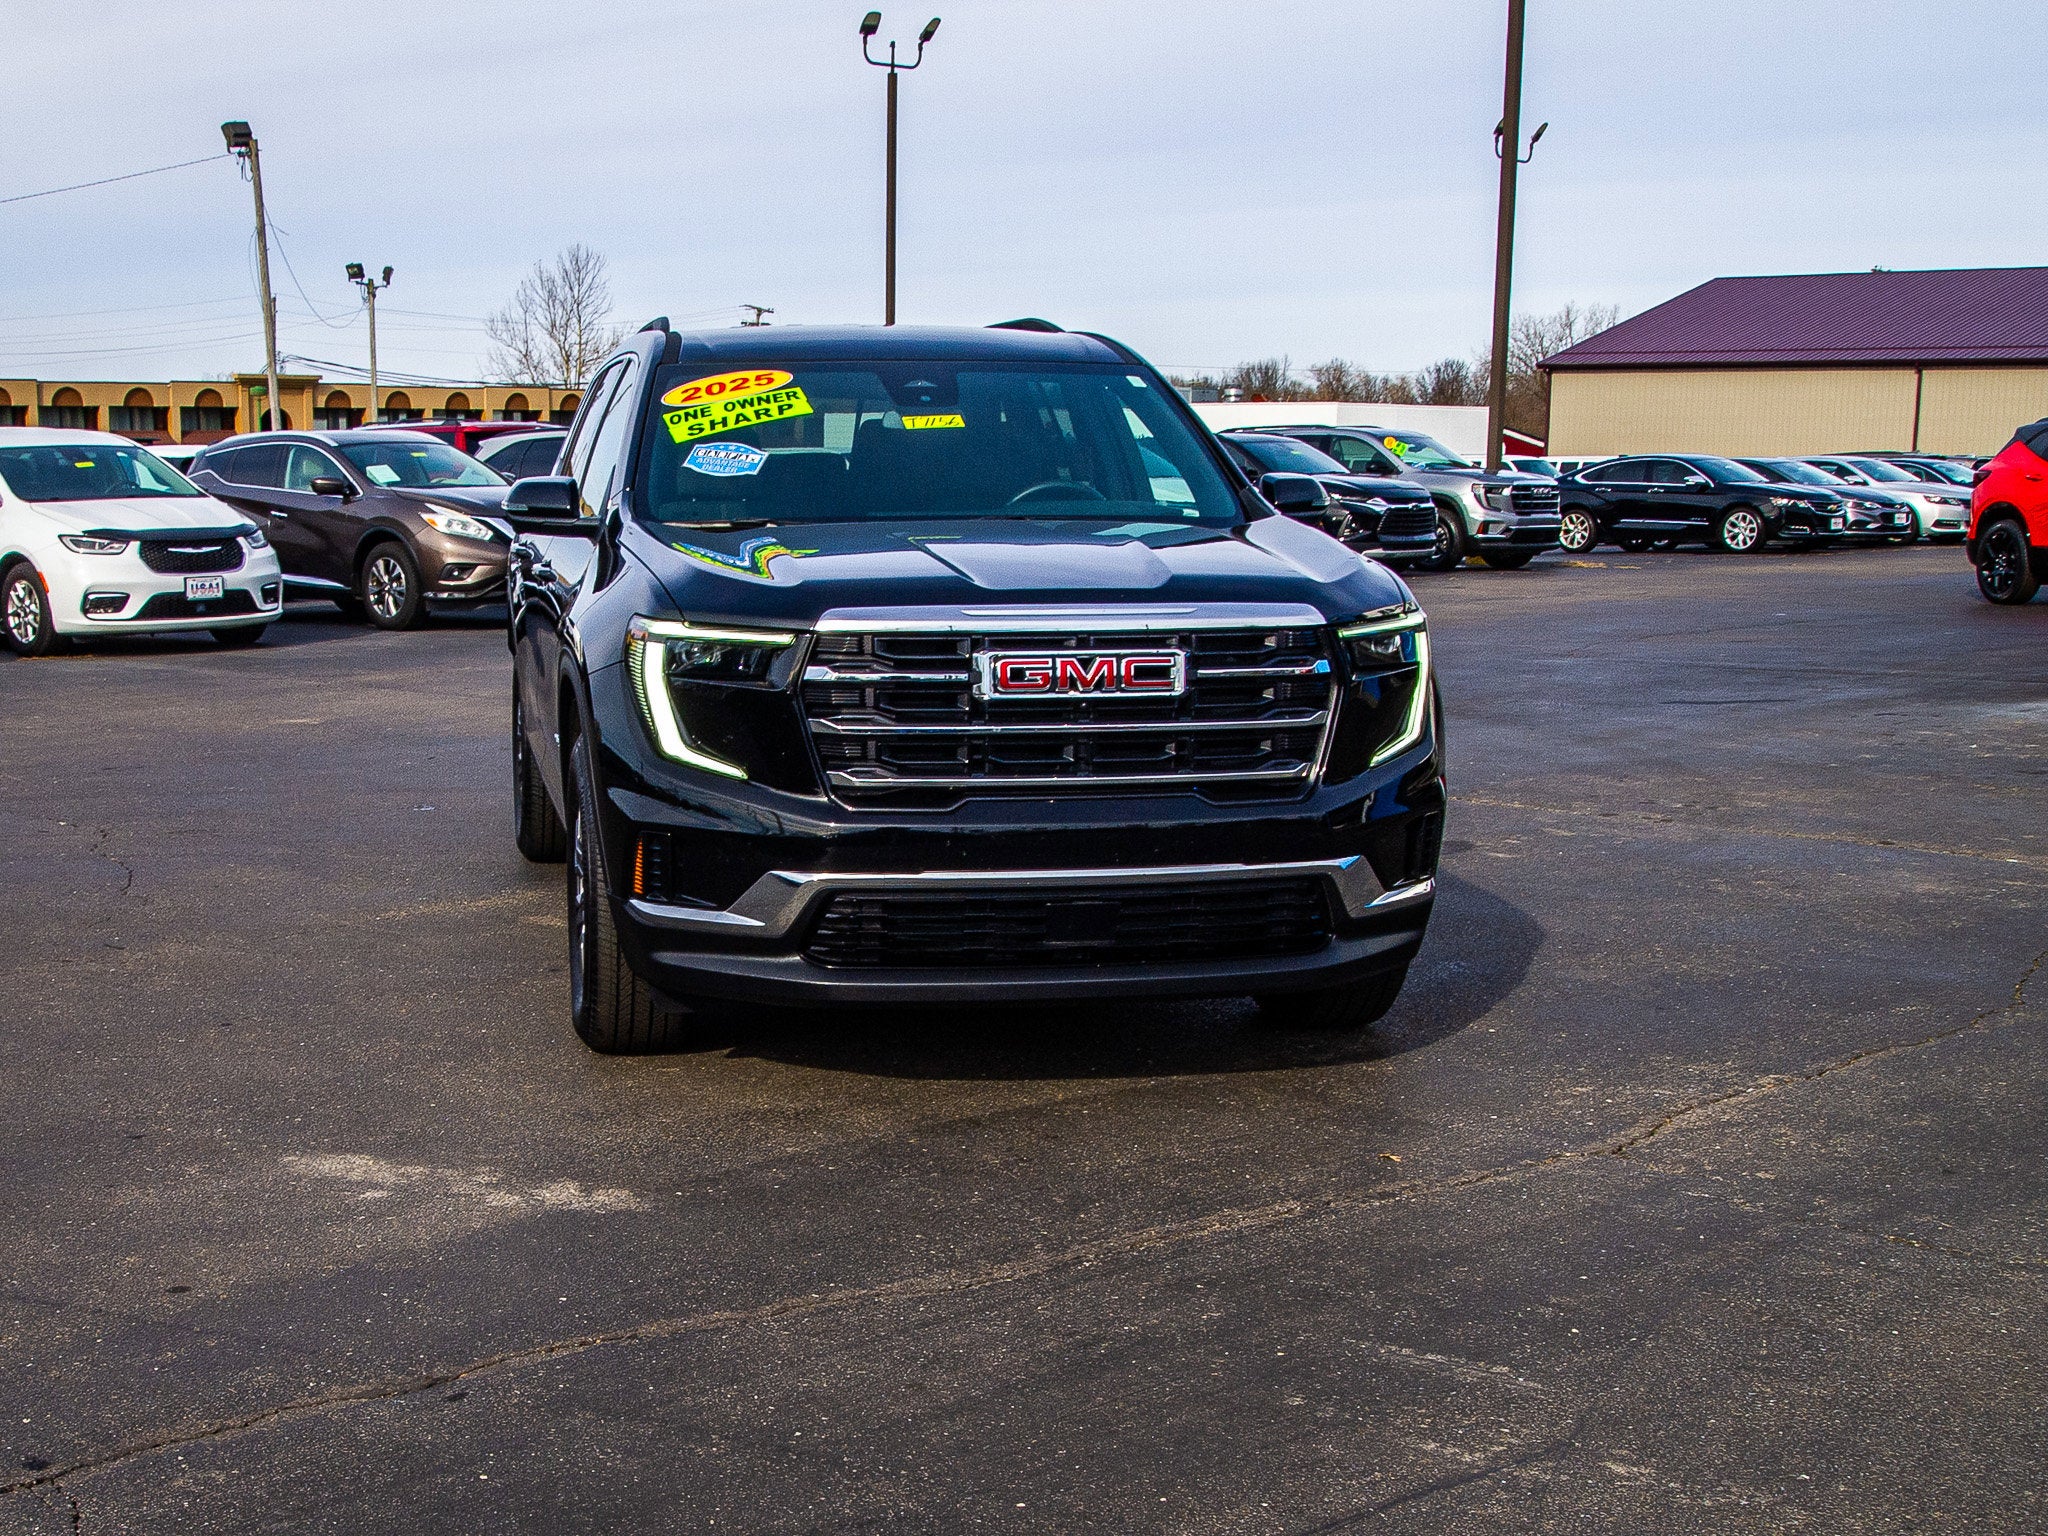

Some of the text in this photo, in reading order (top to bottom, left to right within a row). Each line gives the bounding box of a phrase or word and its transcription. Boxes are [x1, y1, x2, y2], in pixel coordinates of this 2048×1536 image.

[681, 373, 775, 403] 2025
[669, 390, 800, 425] ONE OWNER
[687, 403, 794, 436] SHARP
[190, 582, 220, 595] USA1
[997, 657, 1174, 692] GMC
